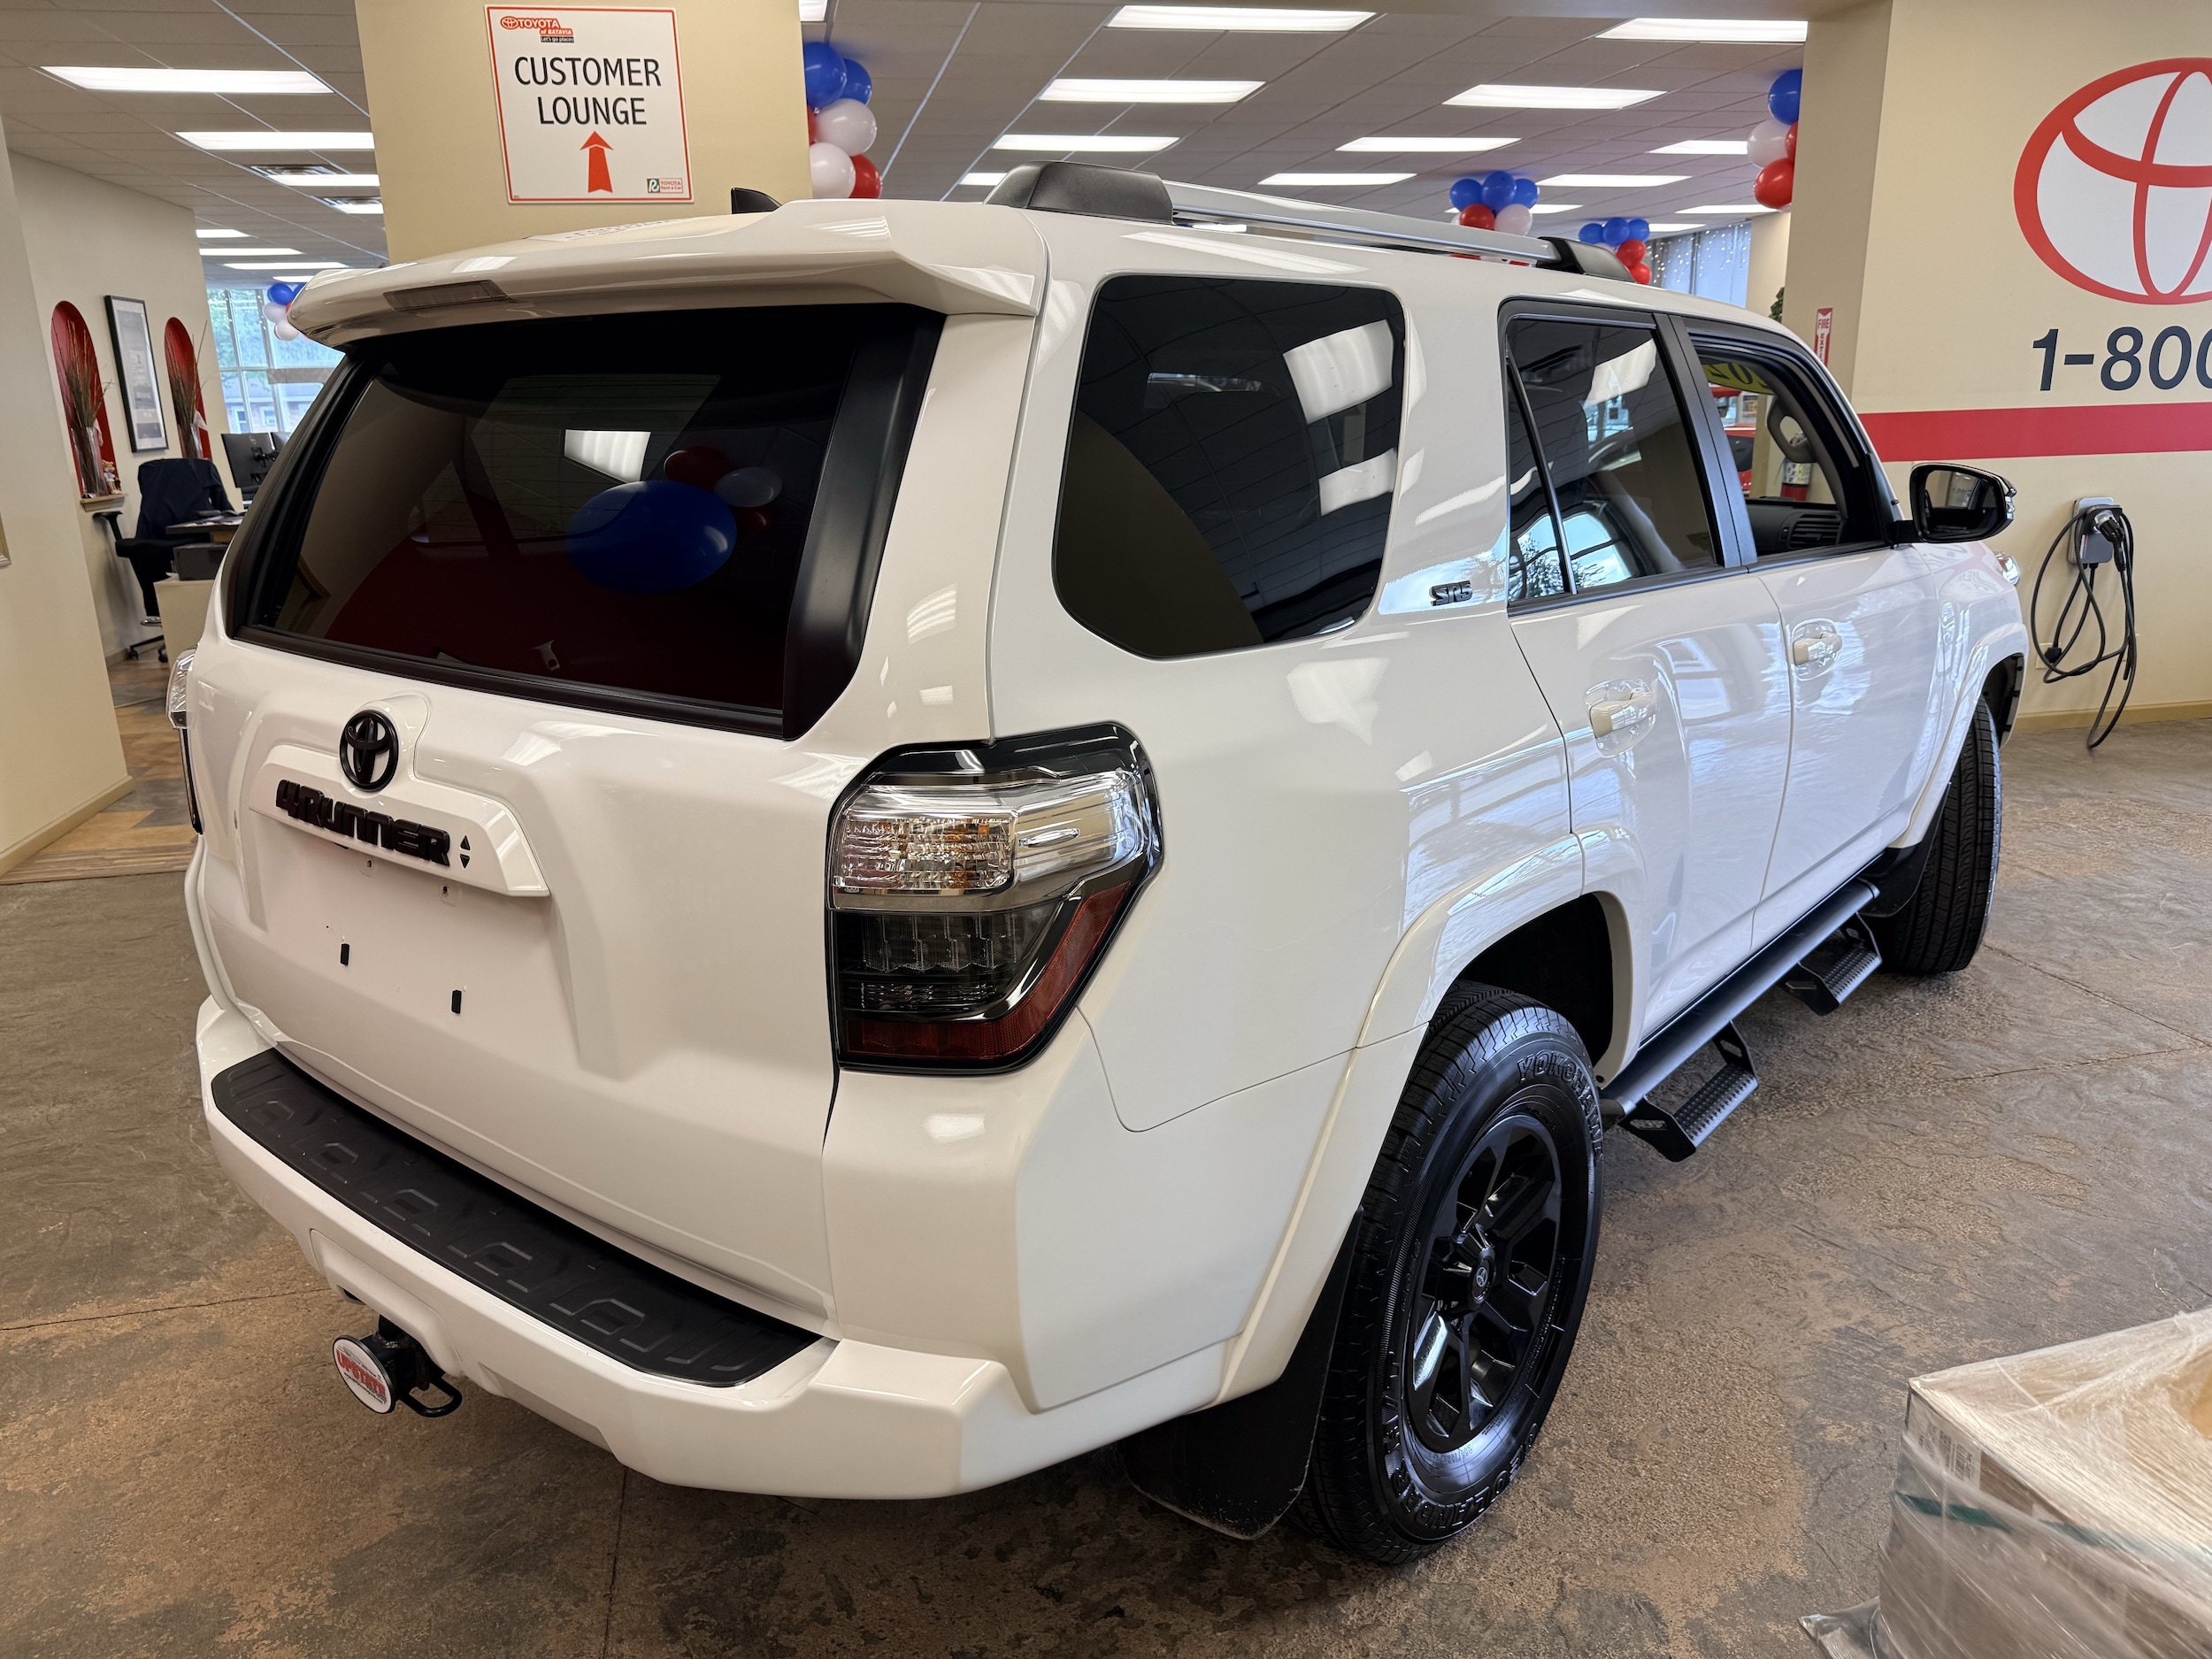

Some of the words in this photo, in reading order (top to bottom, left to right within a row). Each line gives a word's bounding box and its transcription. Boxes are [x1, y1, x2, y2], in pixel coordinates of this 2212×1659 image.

[518, 19, 559, 28] TOYOTA
[514, 56, 662, 87] CUSTOMER
[537, 96, 648, 125] LOUNGE
[1818, 319, 1831, 329] FIRE
[1429, 580, 1473, 606] SR5
[275, 779, 450, 866] 4RUNNER
[1517, 1049, 1604, 1163] YOKOHAMA
